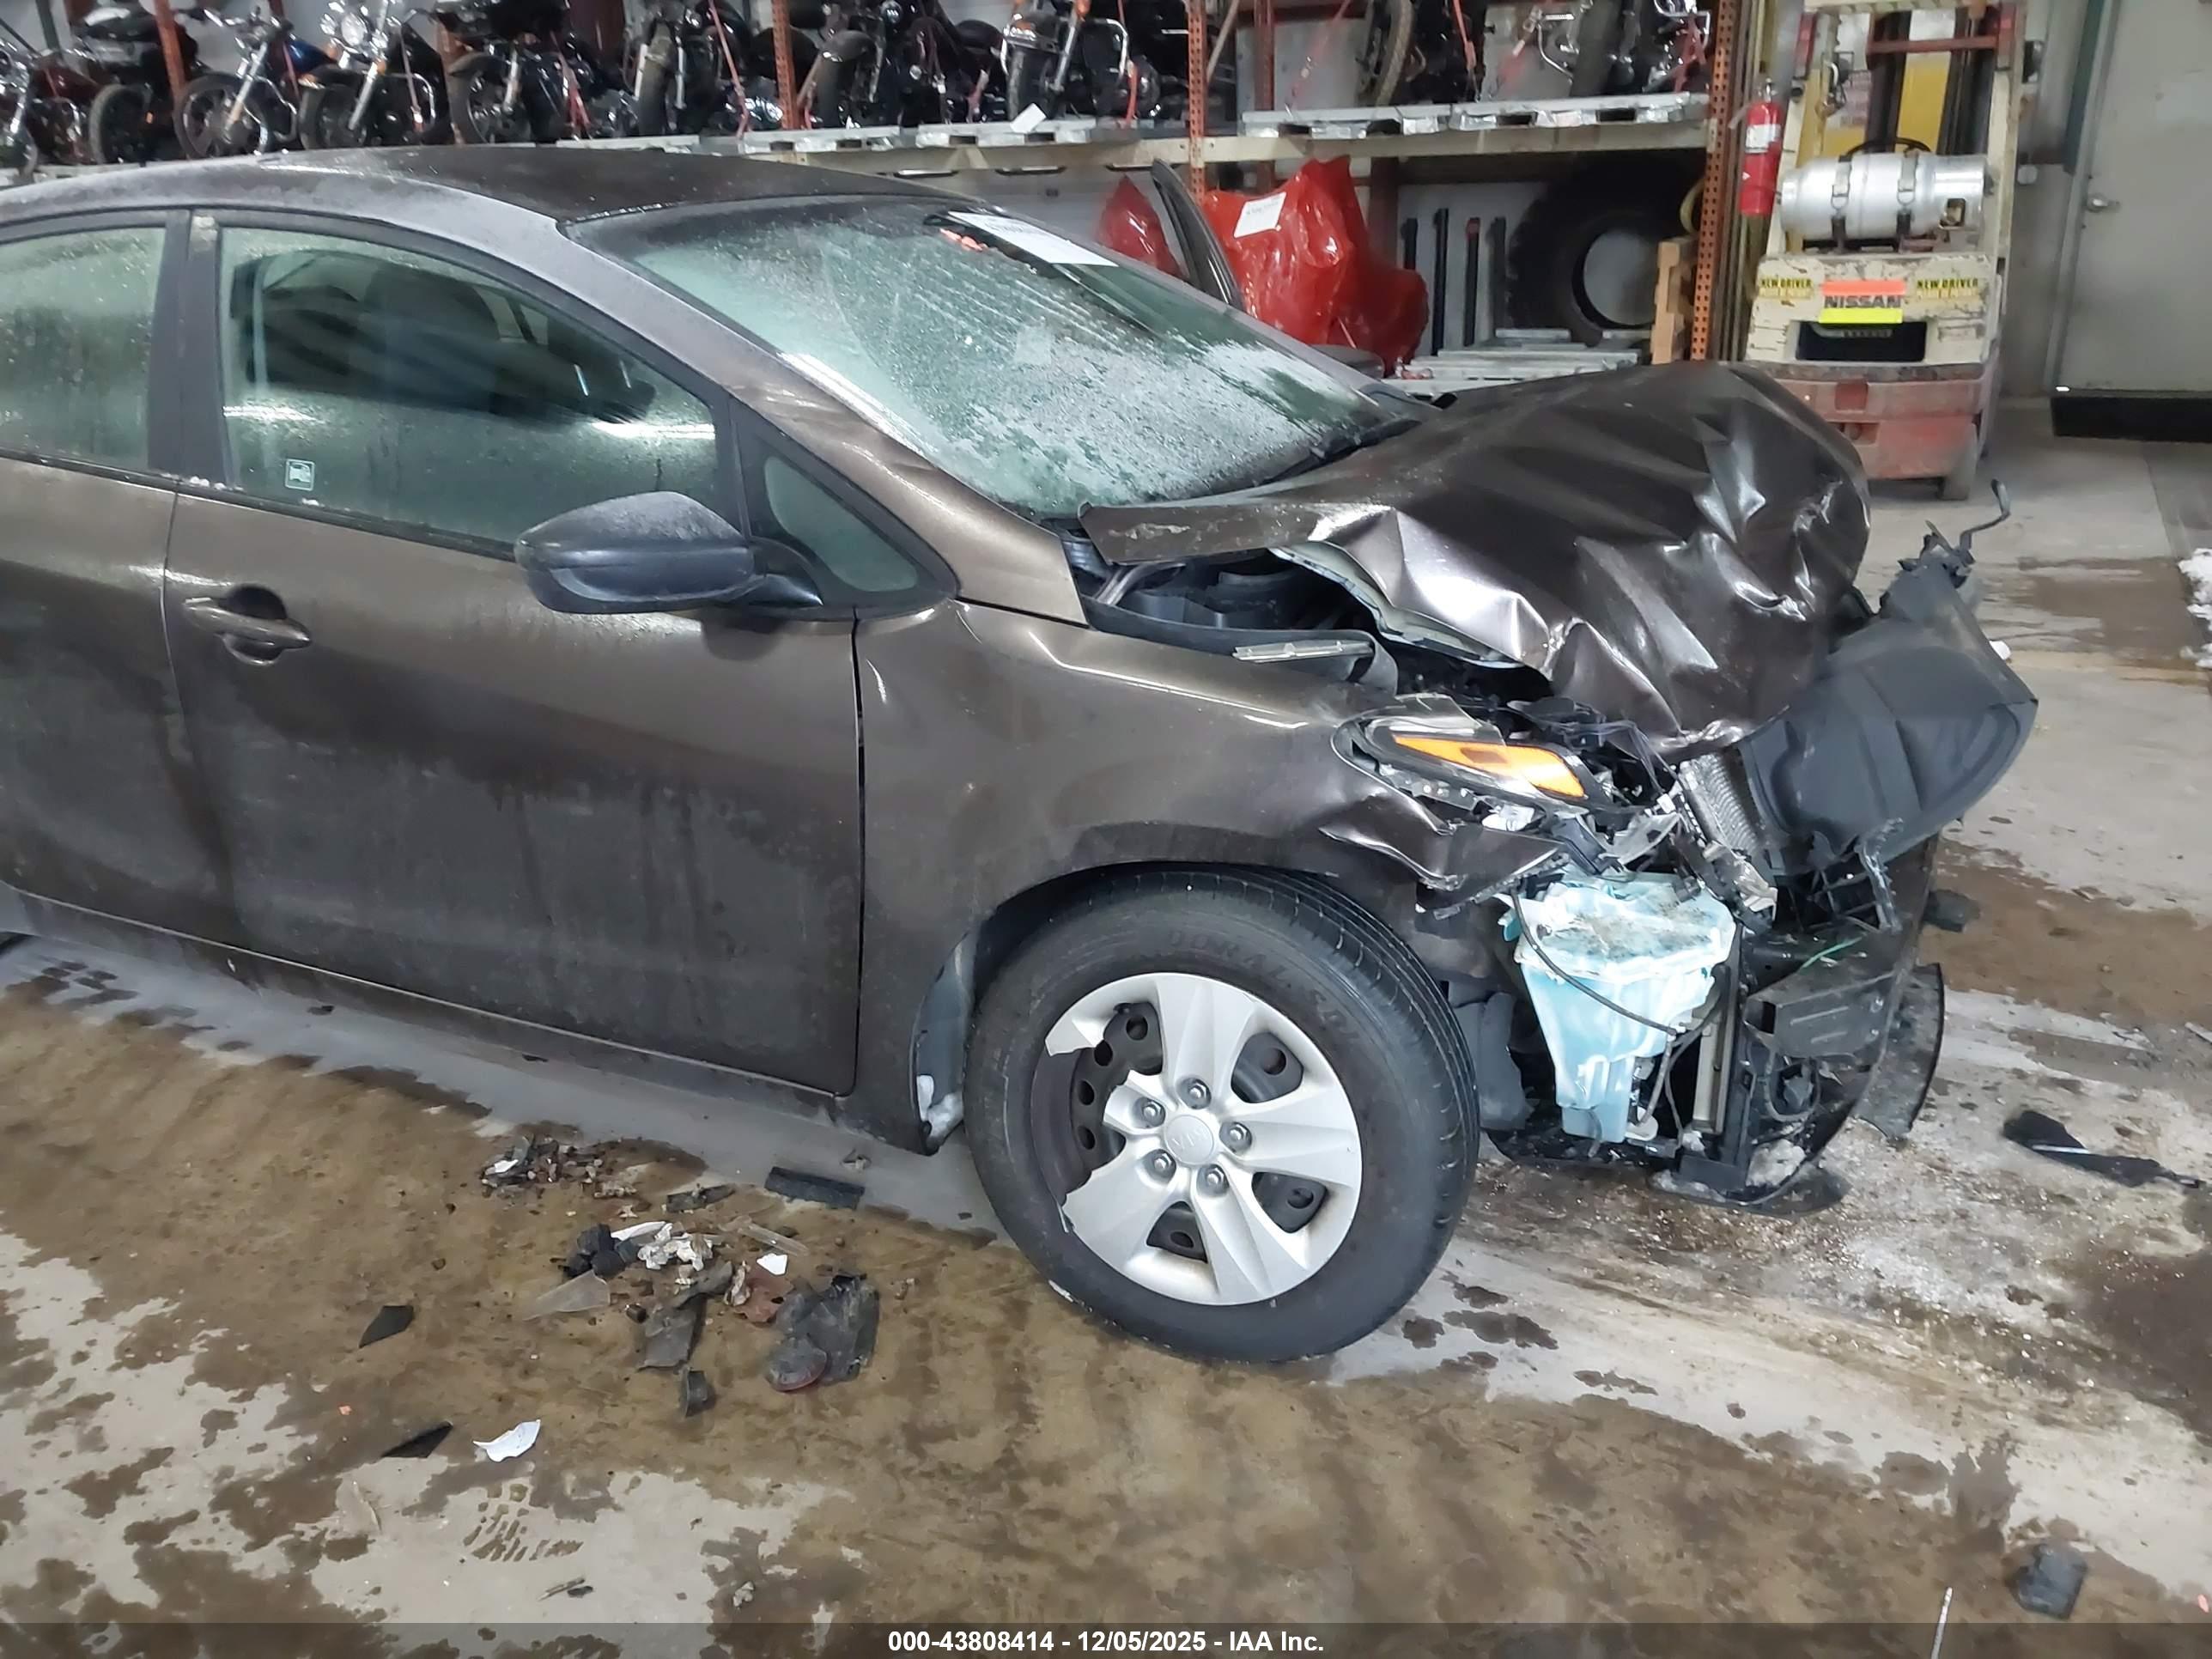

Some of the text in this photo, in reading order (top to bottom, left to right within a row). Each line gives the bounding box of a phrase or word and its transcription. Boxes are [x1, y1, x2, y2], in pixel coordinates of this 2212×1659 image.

[1760, 278, 1812, 289] NEW DRIVER
[1917, 278, 1978, 289] NEW DRIVER
[1823, 295, 1902, 308] NISSAN
